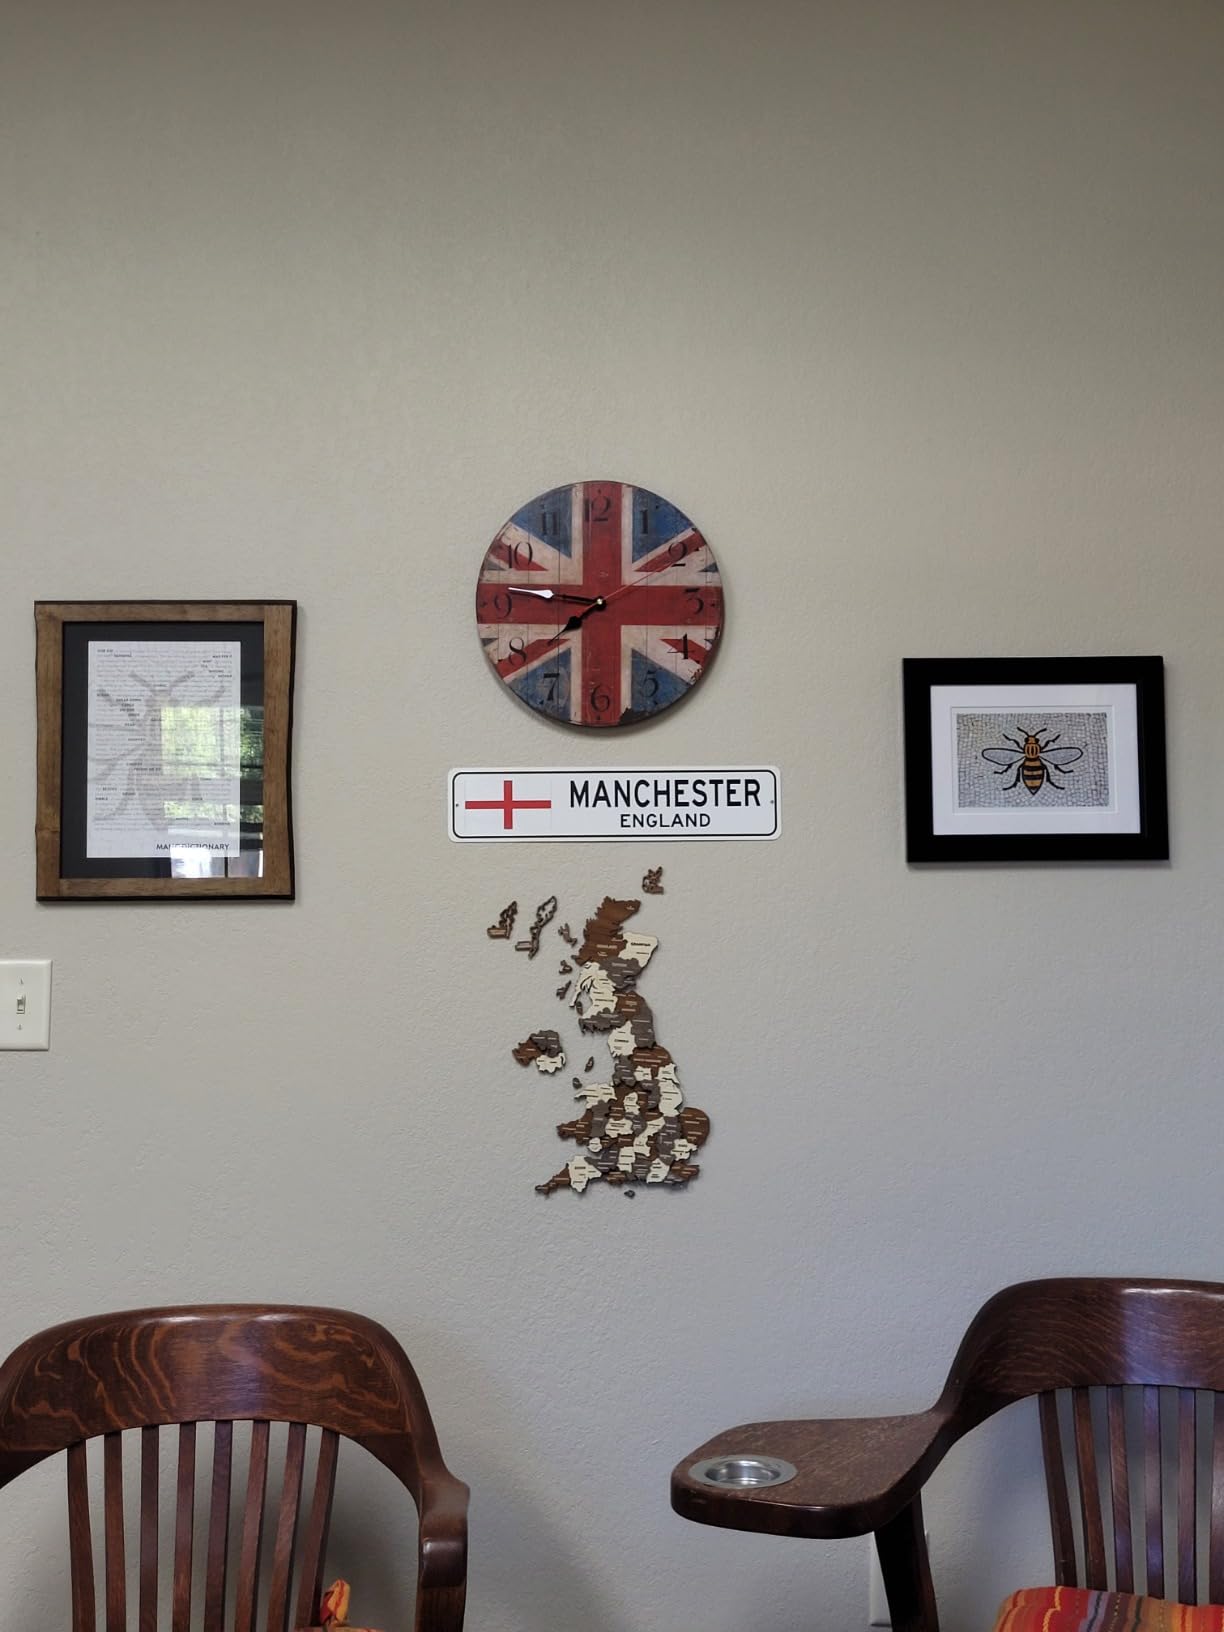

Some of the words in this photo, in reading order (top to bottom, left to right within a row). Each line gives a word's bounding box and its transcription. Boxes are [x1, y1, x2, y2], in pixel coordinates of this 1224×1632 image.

[541, 509, 557, 535] 11
[584, 498, 611, 522] 12
[640, 509, 649, 535] 1
[507, 541, 533, 569] 10
[668, 542, 688, 567] 2
[493, 593, 513, 618] 9
[684, 588, 704, 615] 3
[508, 637, 527, 664] 8
[668, 634, 695, 660] 4
[543, 673, 561, 702] 7
[643, 671, 659, 697] 5
[590, 684, 610, 712] 6
[569, 779, 761, 808] MANCHESTER
[620, 813, 711, 828] ENGLAND
